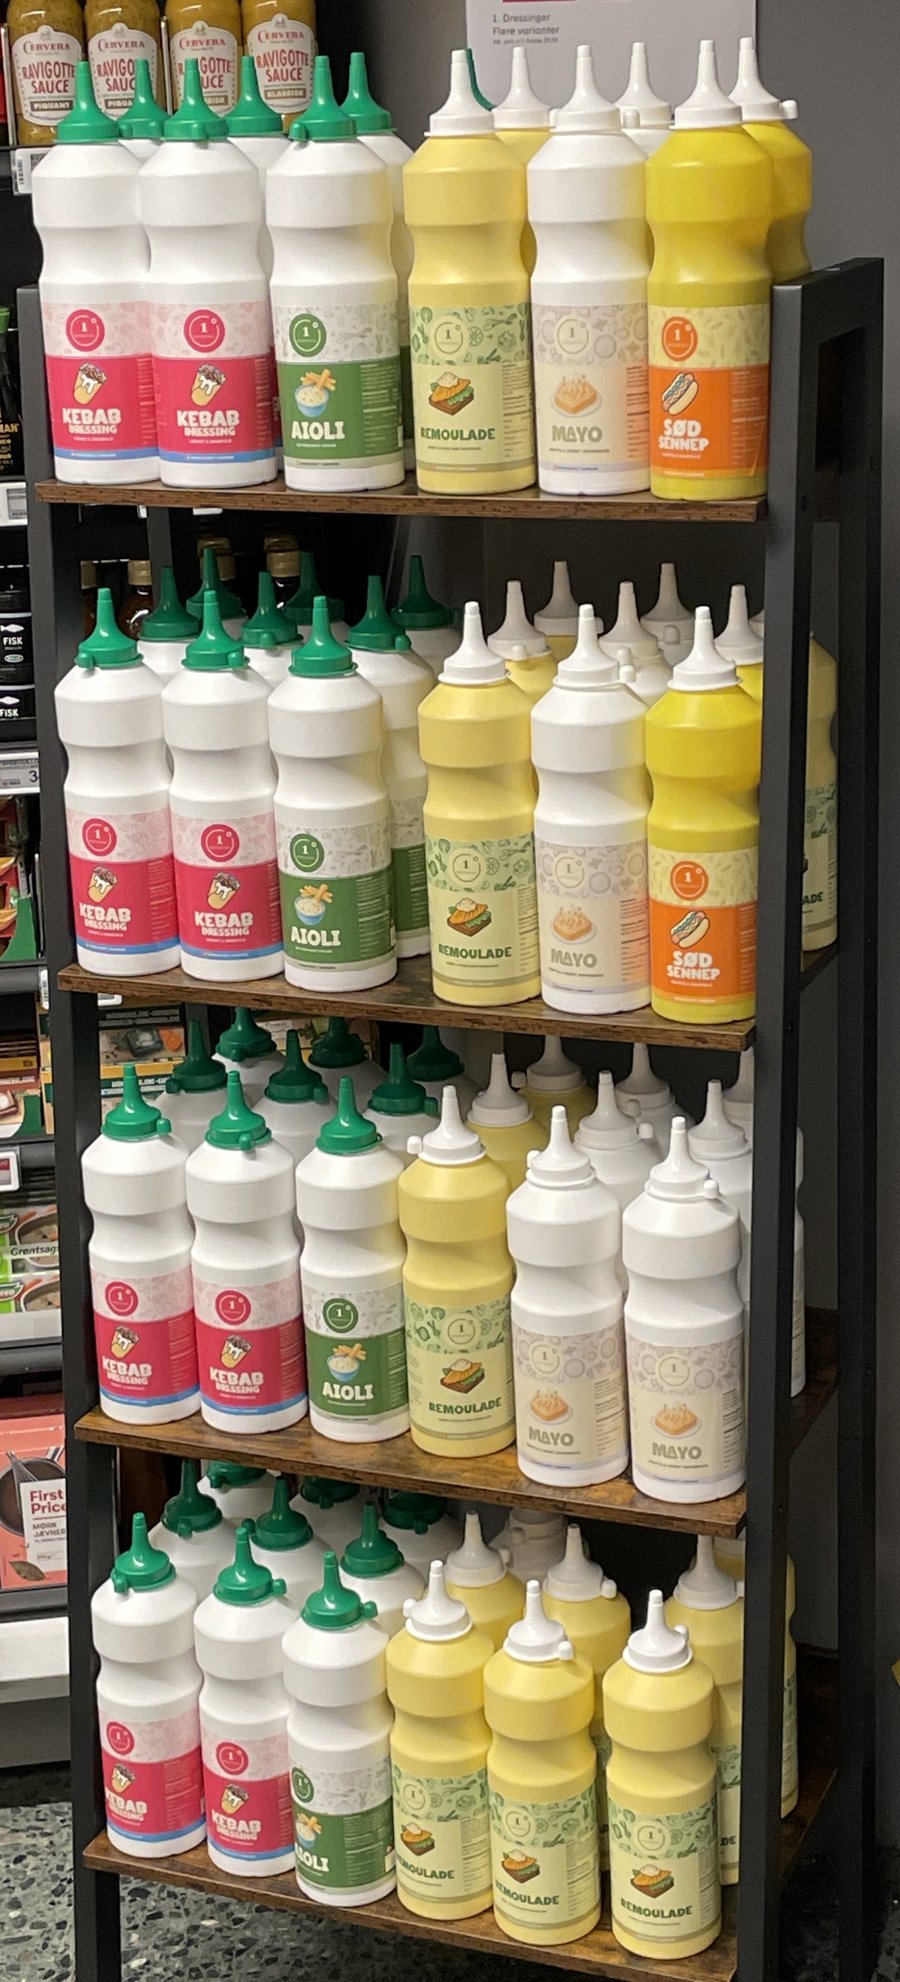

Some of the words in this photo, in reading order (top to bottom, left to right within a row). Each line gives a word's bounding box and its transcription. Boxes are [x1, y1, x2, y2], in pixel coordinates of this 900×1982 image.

[503, 13, 551, 23] Dressinger
[257, 29, 305, 44] CERVERA
[493, 26, 516, 36] Flere
[517, 26, 560, 36] varianter
[23, 41, 71, 56] CERVERA
[98, 38, 145, 53] CERVERA
[179, 37, 226, 51] CERVERA
[256, 49, 309, 69] RAVIGOTTE
[21, 61, 76, 80] RAVIGOTTE
[96, 59, 135, 78] RAVIGO
[265, 67, 303, 83] SAUCE
[31, 79, 70, 94] SAUCE
[106, 78, 136, 92] SAUC
[302, 326, 310, 337] 1
[62, 407, 122, 426] KEBAB
[176, 409, 240, 428] KEBAB
[68, 424, 118, 436] DRESSING
[184, 426, 236, 437] DRESSING
[291, 420, 346, 441] AIOLI
[420, 426, 496, 442] REMOULADE
[552, 425, 603, 443] MAYO
[662, 418, 702, 438] SØD
[658, 436, 710, 452] SENNEP
[3, 636, 24, 646] FISK
[79, 902, 132, 924] KEBAB
[194, 911, 254, 928] KEBAB
[84, 919, 127, 931] DRESSING
[201, 926, 250, 937] DRESSING
[290, 926, 342, 947] AIOLI
[438, 943, 513, 960] REMOULADE
[550, 949, 598, 969] MAYO
[672, 950, 714, 968] SØD
[666, 965, 721, 981] SENNEP
[101, 1355, 153, 1377] KEBAB
[106, 1371, 149, 1386] DRESSING
[209, 1366, 265, 1386] KEBAB
[215, 1382, 261, 1395] DRESSING
[322, 1381, 374, 1400] AIOLI
[428, 1397, 503, 1415] REMOULADE
[528, 1426, 575, 1447] MAYO
[651, 1441, 702, 1461] MAYO
[30, 1488, 64, 1502] First
[211, 1808, 262, 1833] KEBAB
[620, 1897, 694, 1919] REMOULADE
